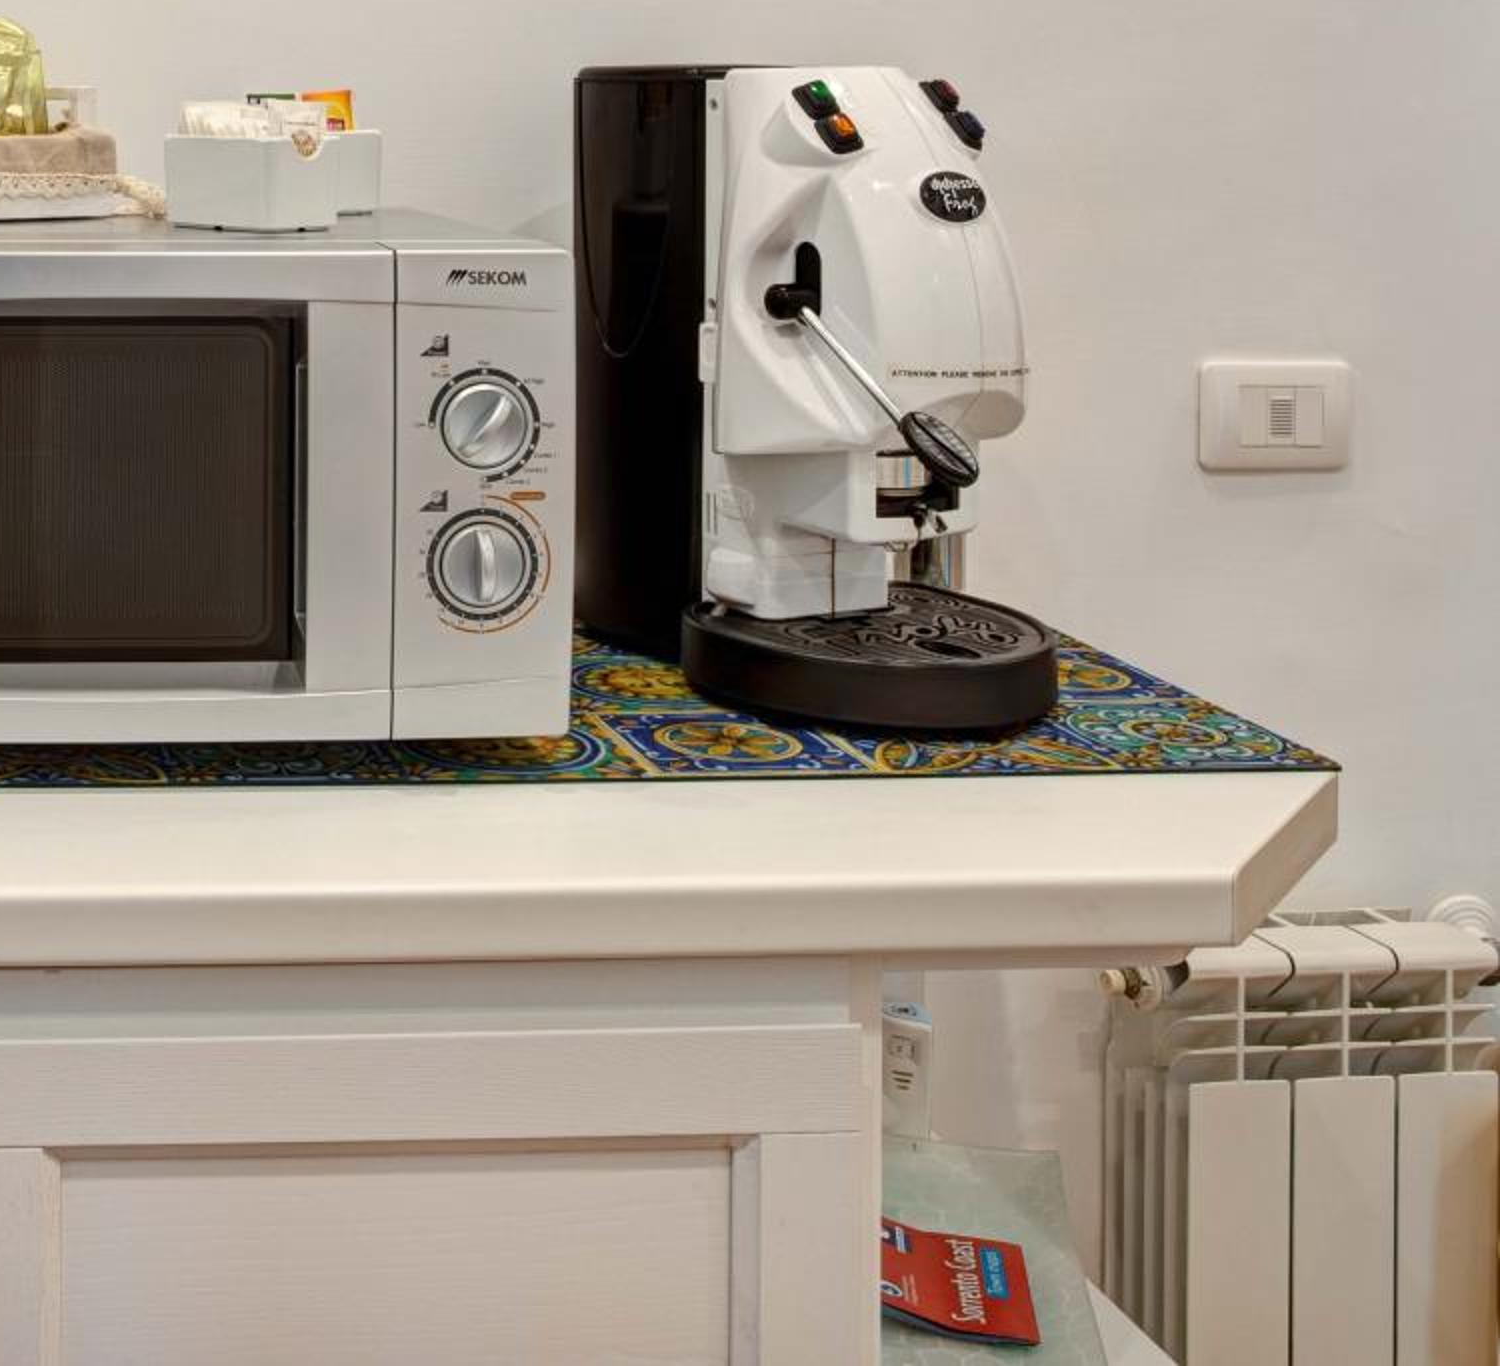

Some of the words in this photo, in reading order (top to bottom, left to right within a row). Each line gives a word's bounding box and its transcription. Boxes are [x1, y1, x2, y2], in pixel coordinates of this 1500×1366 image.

[467, 271, 527, 285] SEKOM
[944, 1238, 977, 1270] Coast
[951, 1271, 987, 1326] Sorrento
